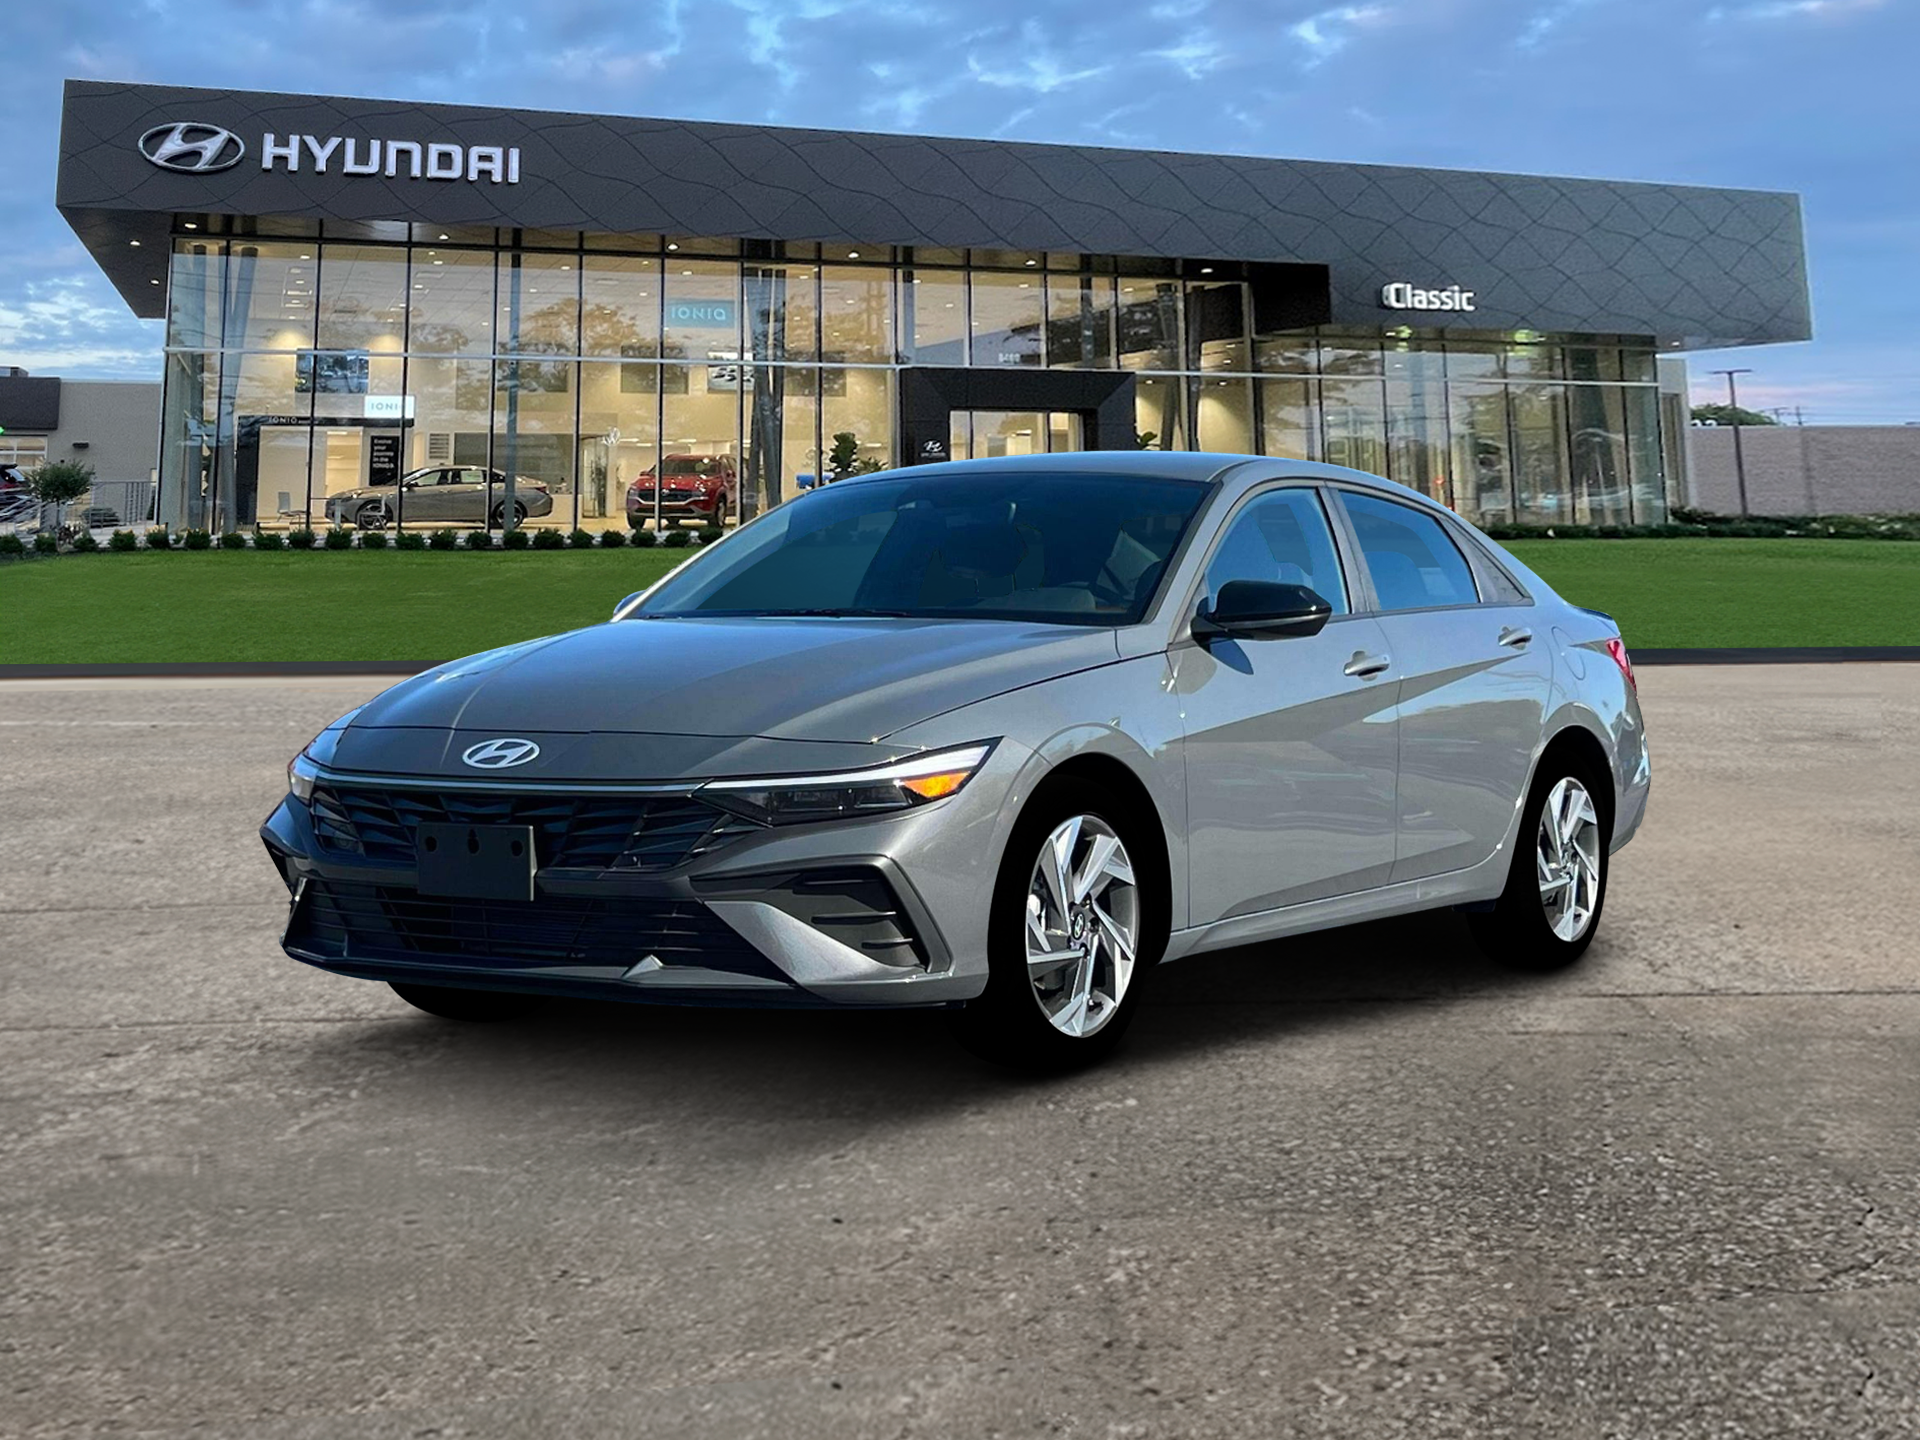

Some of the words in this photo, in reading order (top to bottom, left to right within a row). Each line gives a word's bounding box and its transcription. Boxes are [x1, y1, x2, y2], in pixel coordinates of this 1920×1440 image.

[261, 132, 520, 184] HYUNDAI
[1382, 282, 1476, 311] Classic
[671, 306, 726, 320] IONIQ
[370, 402, 404, 411] IONI
